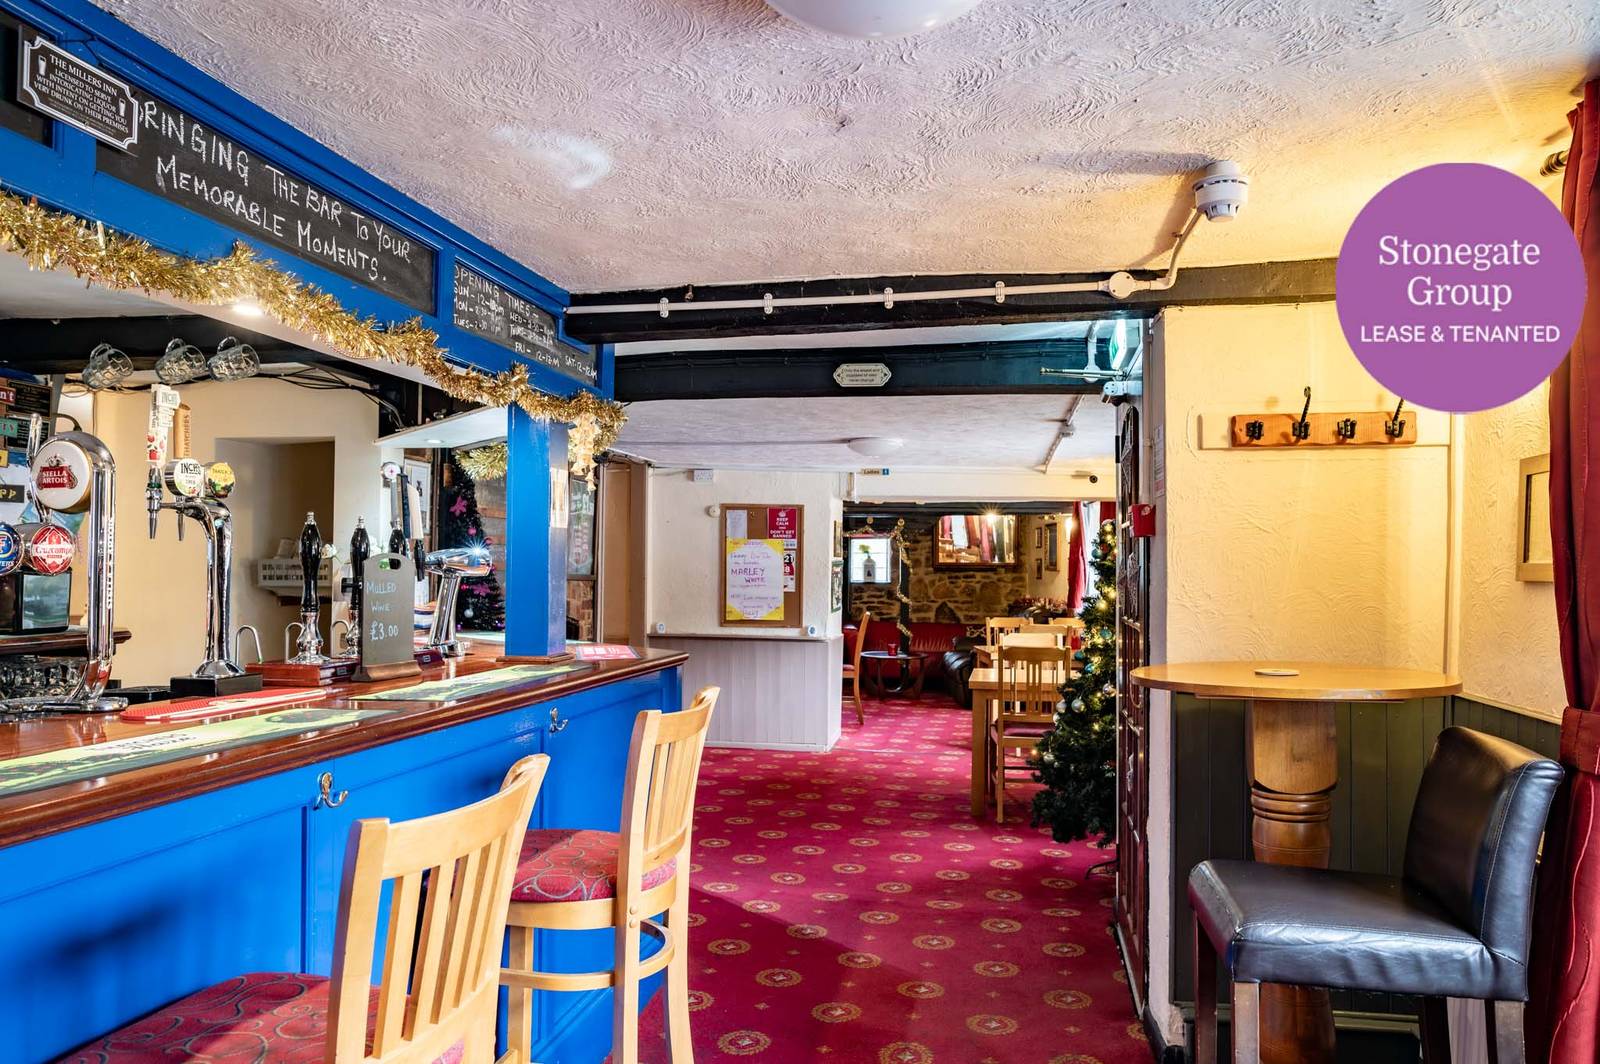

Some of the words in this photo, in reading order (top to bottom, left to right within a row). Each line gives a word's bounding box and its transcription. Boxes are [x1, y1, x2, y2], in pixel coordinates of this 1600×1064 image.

[50, 54, 66, 69] THE
[68, 64, 102, 87] MILLERS
[103, 81, 117, 97] INN
[50, 74, 93, 101] INTOXICATING
[94, 97, 116, 113] LIQUOR
[55, 69, 84, 88] LICENSED
[85, 83, 93, 94] TO
[94, 88, 111, 103] SERVE
[34, 81, 50, 95] VERY
[50, 90, 72, 106] DRUNK
[73, 102, 84, 112] ON
[84, 106, 102, 122] THEIR
[102, 115, 128, 133] PREMISES
[36, 75, 55, 89] WITH
[55, 86, 78, 101] INTENT
[78, 96, 88, 106] ON
[89, 102, 114, 119] GETTING
[115, 114, 127, 125] YOU
[140, 101, 249, 187] RINGING
[265, 164, 299, 205] THE
[306, 186, 342, 227] BAR
[373, 220, 411, 264] YOUR
[155, 154, 285, 238] MEMORABLE
[42, 470, 68, 478] STELLA
[366, 581, 398, 594] MULLED
[731, 567, 766, 576] MARLEY
[370, 620, 399, 641] £3.00
